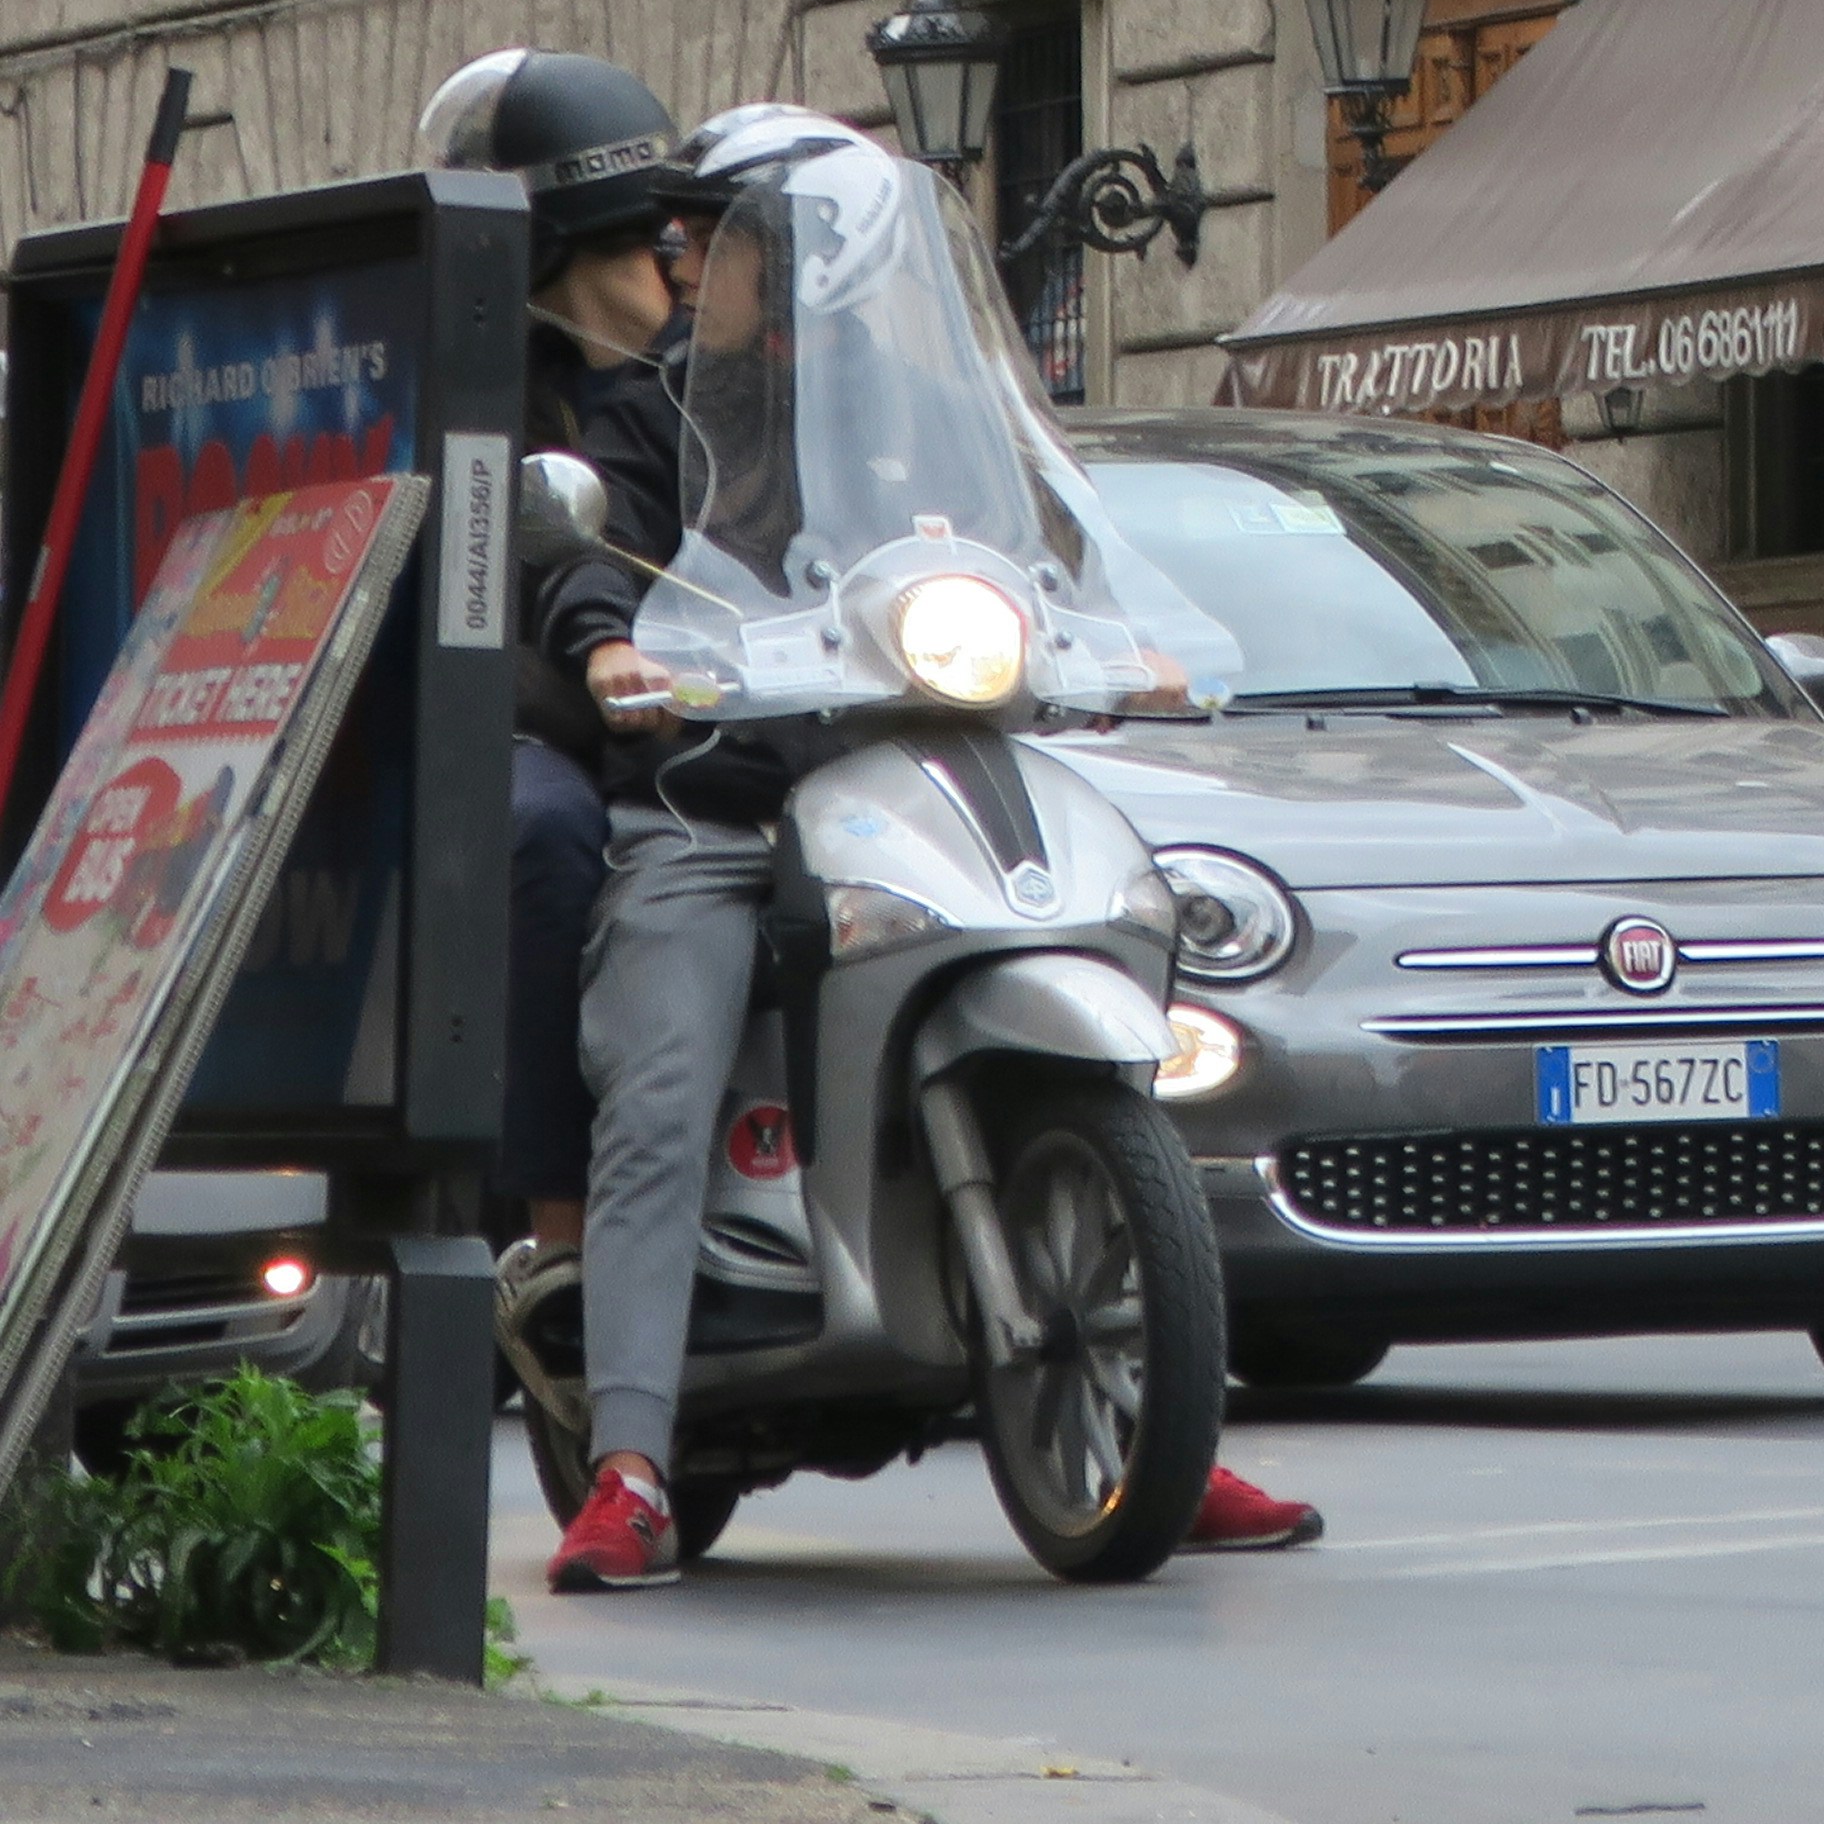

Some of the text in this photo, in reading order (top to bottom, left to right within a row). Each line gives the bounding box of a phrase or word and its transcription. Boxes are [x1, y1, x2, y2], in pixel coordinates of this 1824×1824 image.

[1317, 333, 1523, 407] TRATTORIA
[1620, 940, 1664, 974] FIAT
[1572, 1061, 1618, 1108] FD
[1630, 1058, 1744, 1106] 567ZC
